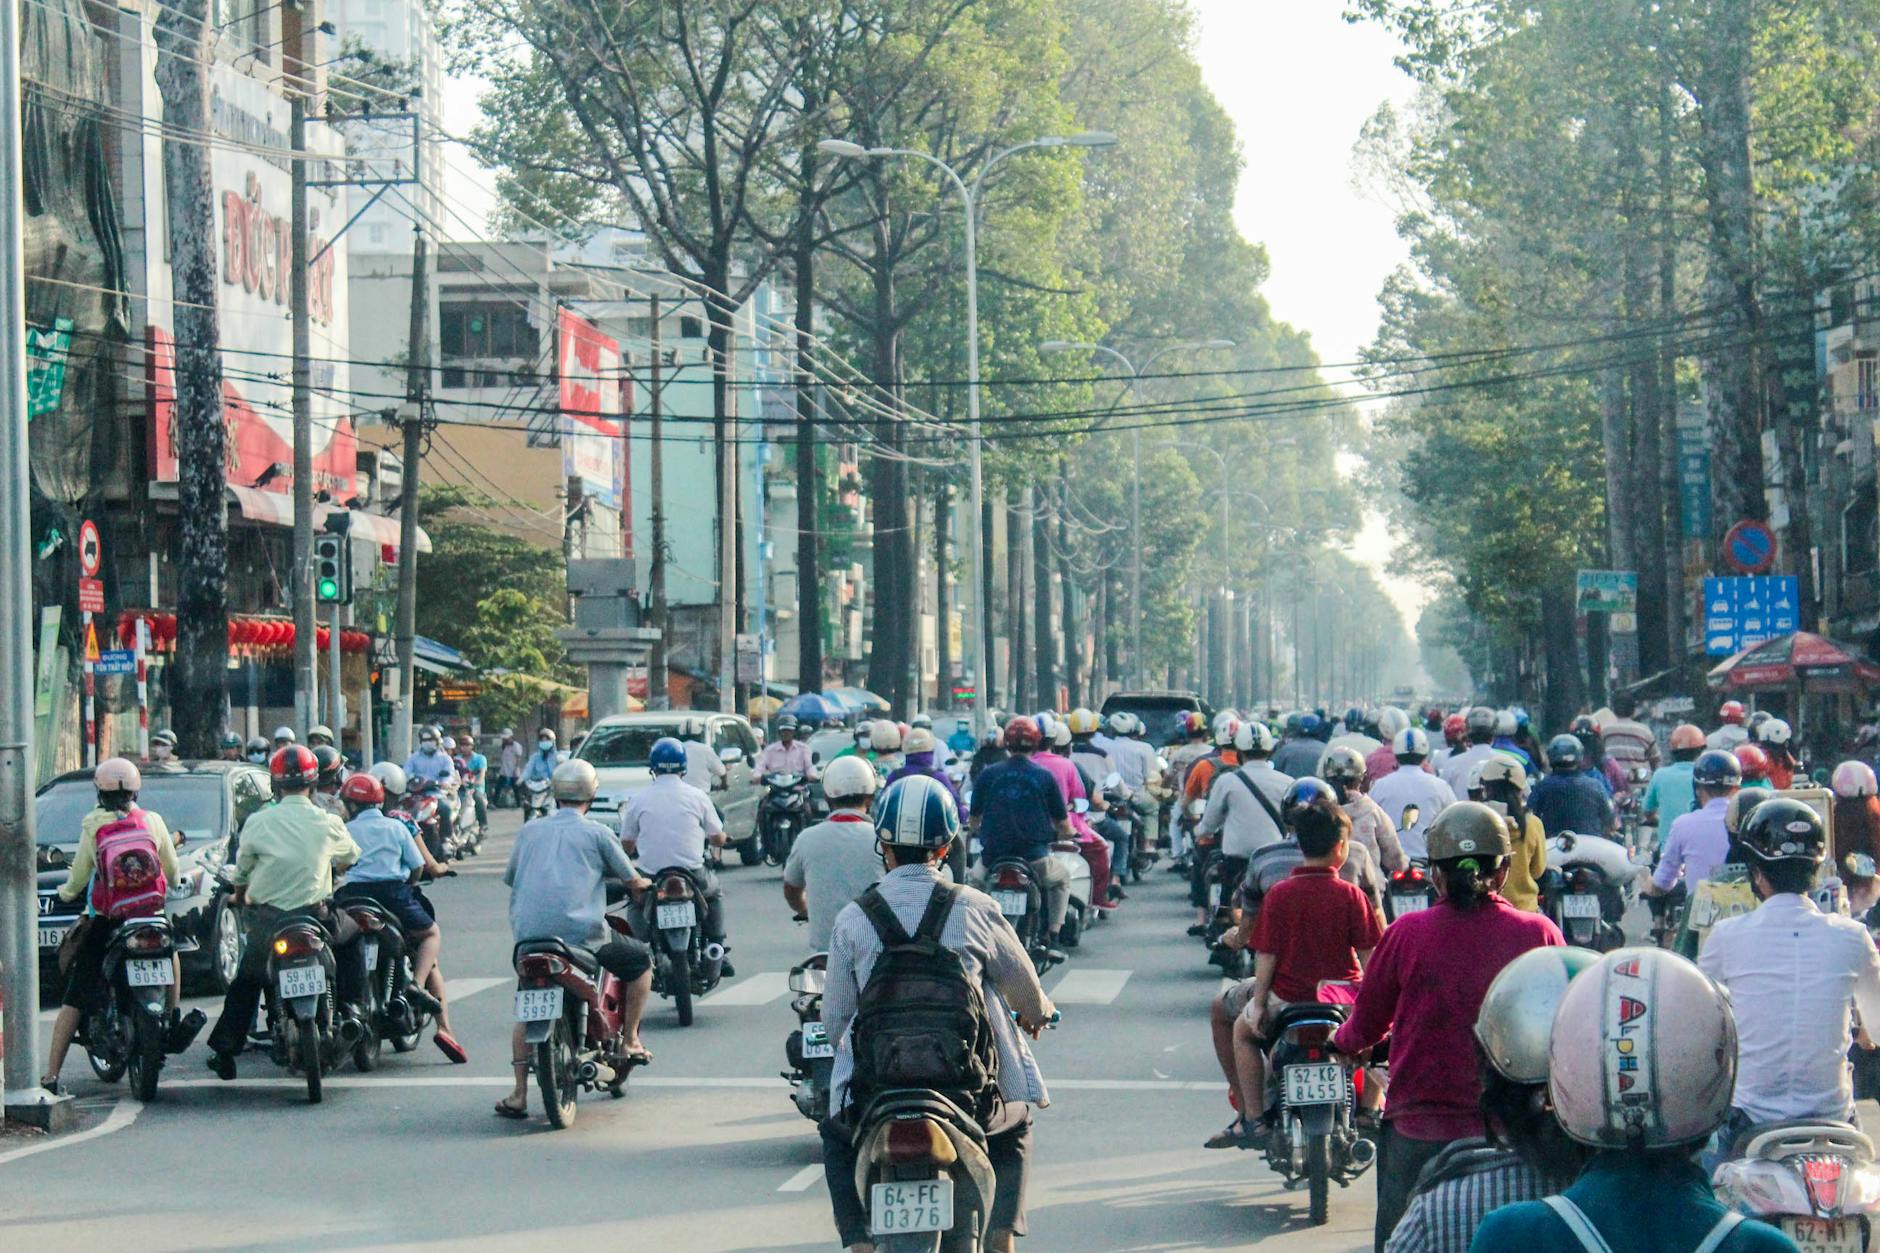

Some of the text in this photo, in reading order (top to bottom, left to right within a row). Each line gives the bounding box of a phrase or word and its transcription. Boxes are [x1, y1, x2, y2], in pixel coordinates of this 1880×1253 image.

[522, 1003, 555, 1019] 5997
[1295, 1083, 1337, 1101] 8455
[884, 1184, 940, 1206] 64-FC
[884, 1206, 940, 1230] 0376
